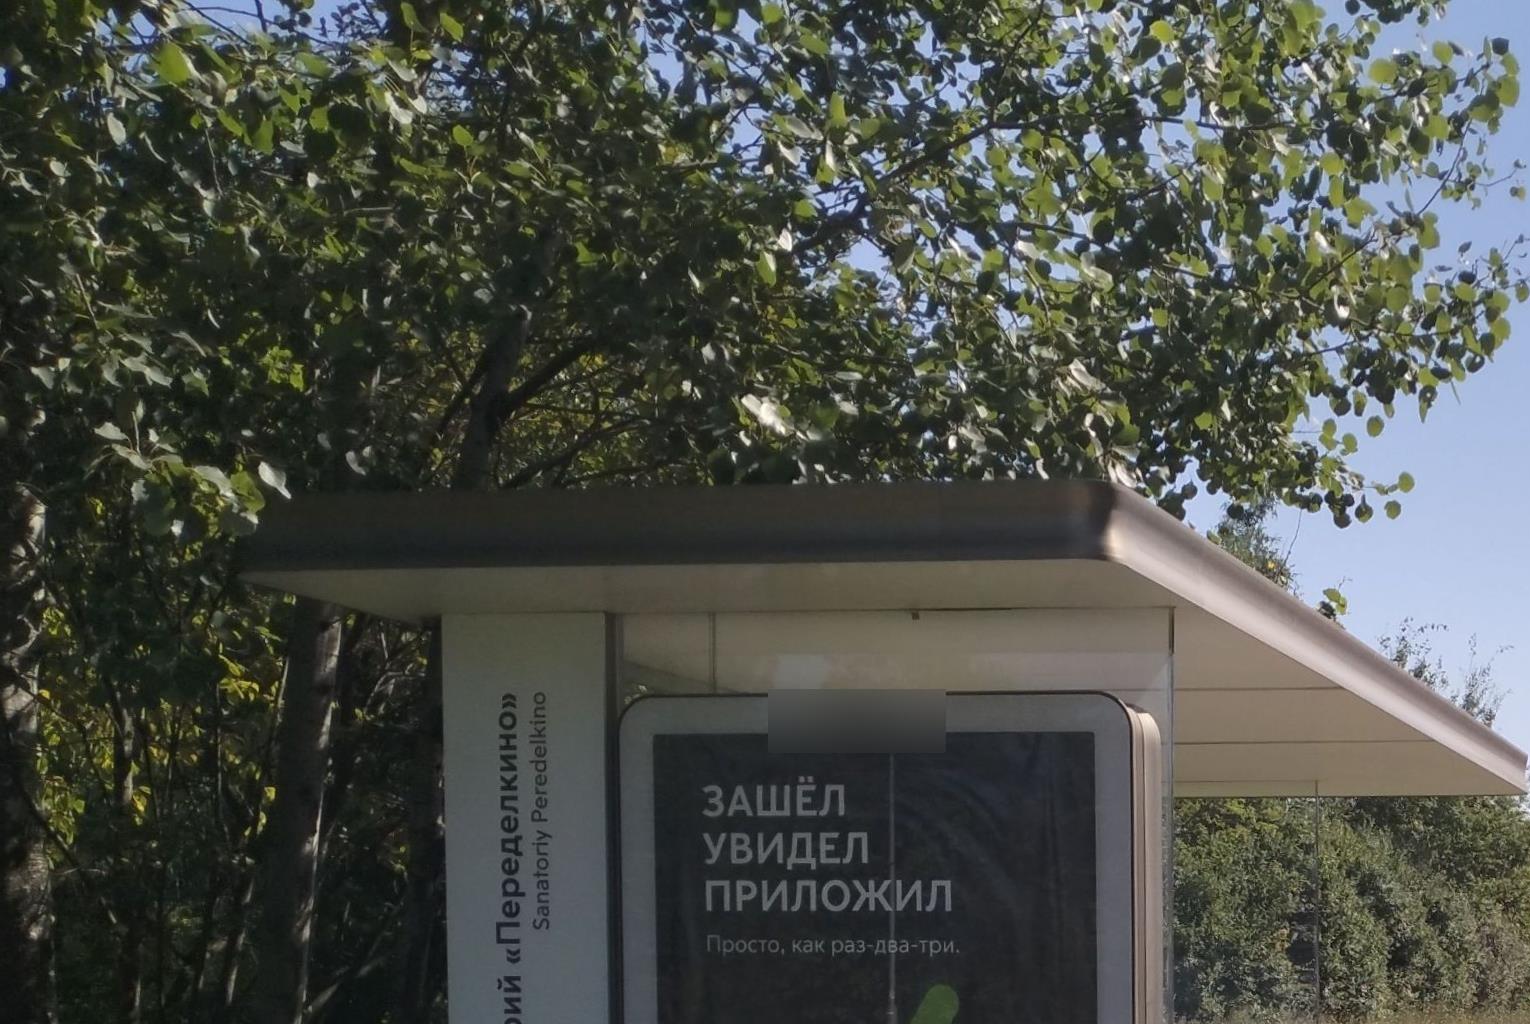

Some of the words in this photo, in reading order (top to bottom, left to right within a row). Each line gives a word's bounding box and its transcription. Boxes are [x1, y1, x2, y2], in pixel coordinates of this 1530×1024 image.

[528, 691, 549, 823] Peredelkino
[702, 776, 846, 817] ЗАШЁЛ
[496, 692, 526, 965] «Переделкино»
[703, 832, 869, 870] УВИДЕЛ
[531, 829, 552, 931] Sanatoriy
[705, 880, 952, 912] ПРИЛОЖИЛ
[706, 935, 785, 956] Просто,
[791, 937, 825, 954] как
[831, 938, 960, 957] раз-два-три.
